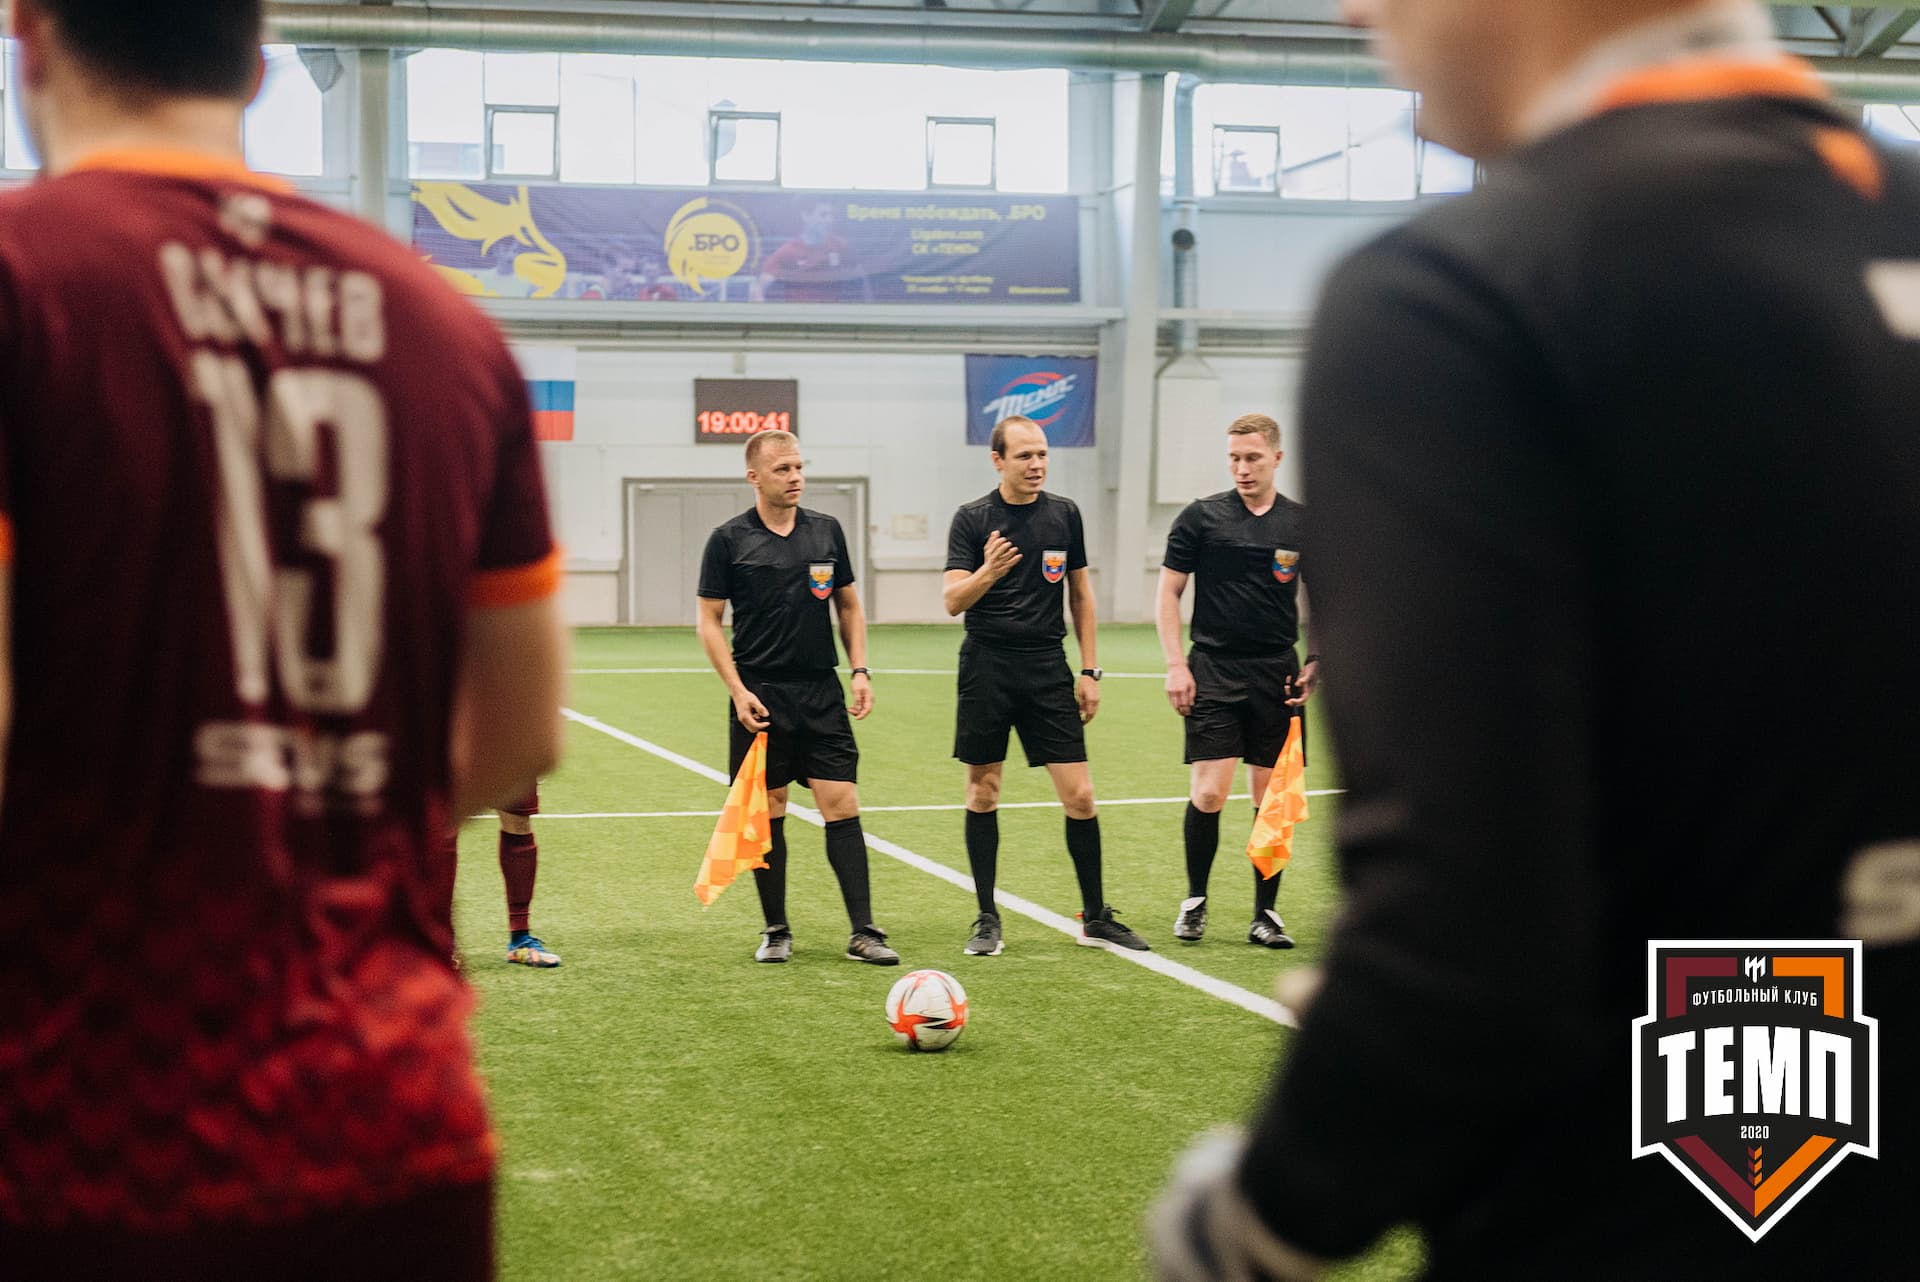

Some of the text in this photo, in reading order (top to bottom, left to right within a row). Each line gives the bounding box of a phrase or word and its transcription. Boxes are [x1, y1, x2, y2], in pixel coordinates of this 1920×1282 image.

[687, 233, 741, 252] .БРО
[697, 410, 790, 433] 19:00:41
[192, 346, 391, 715] 13
